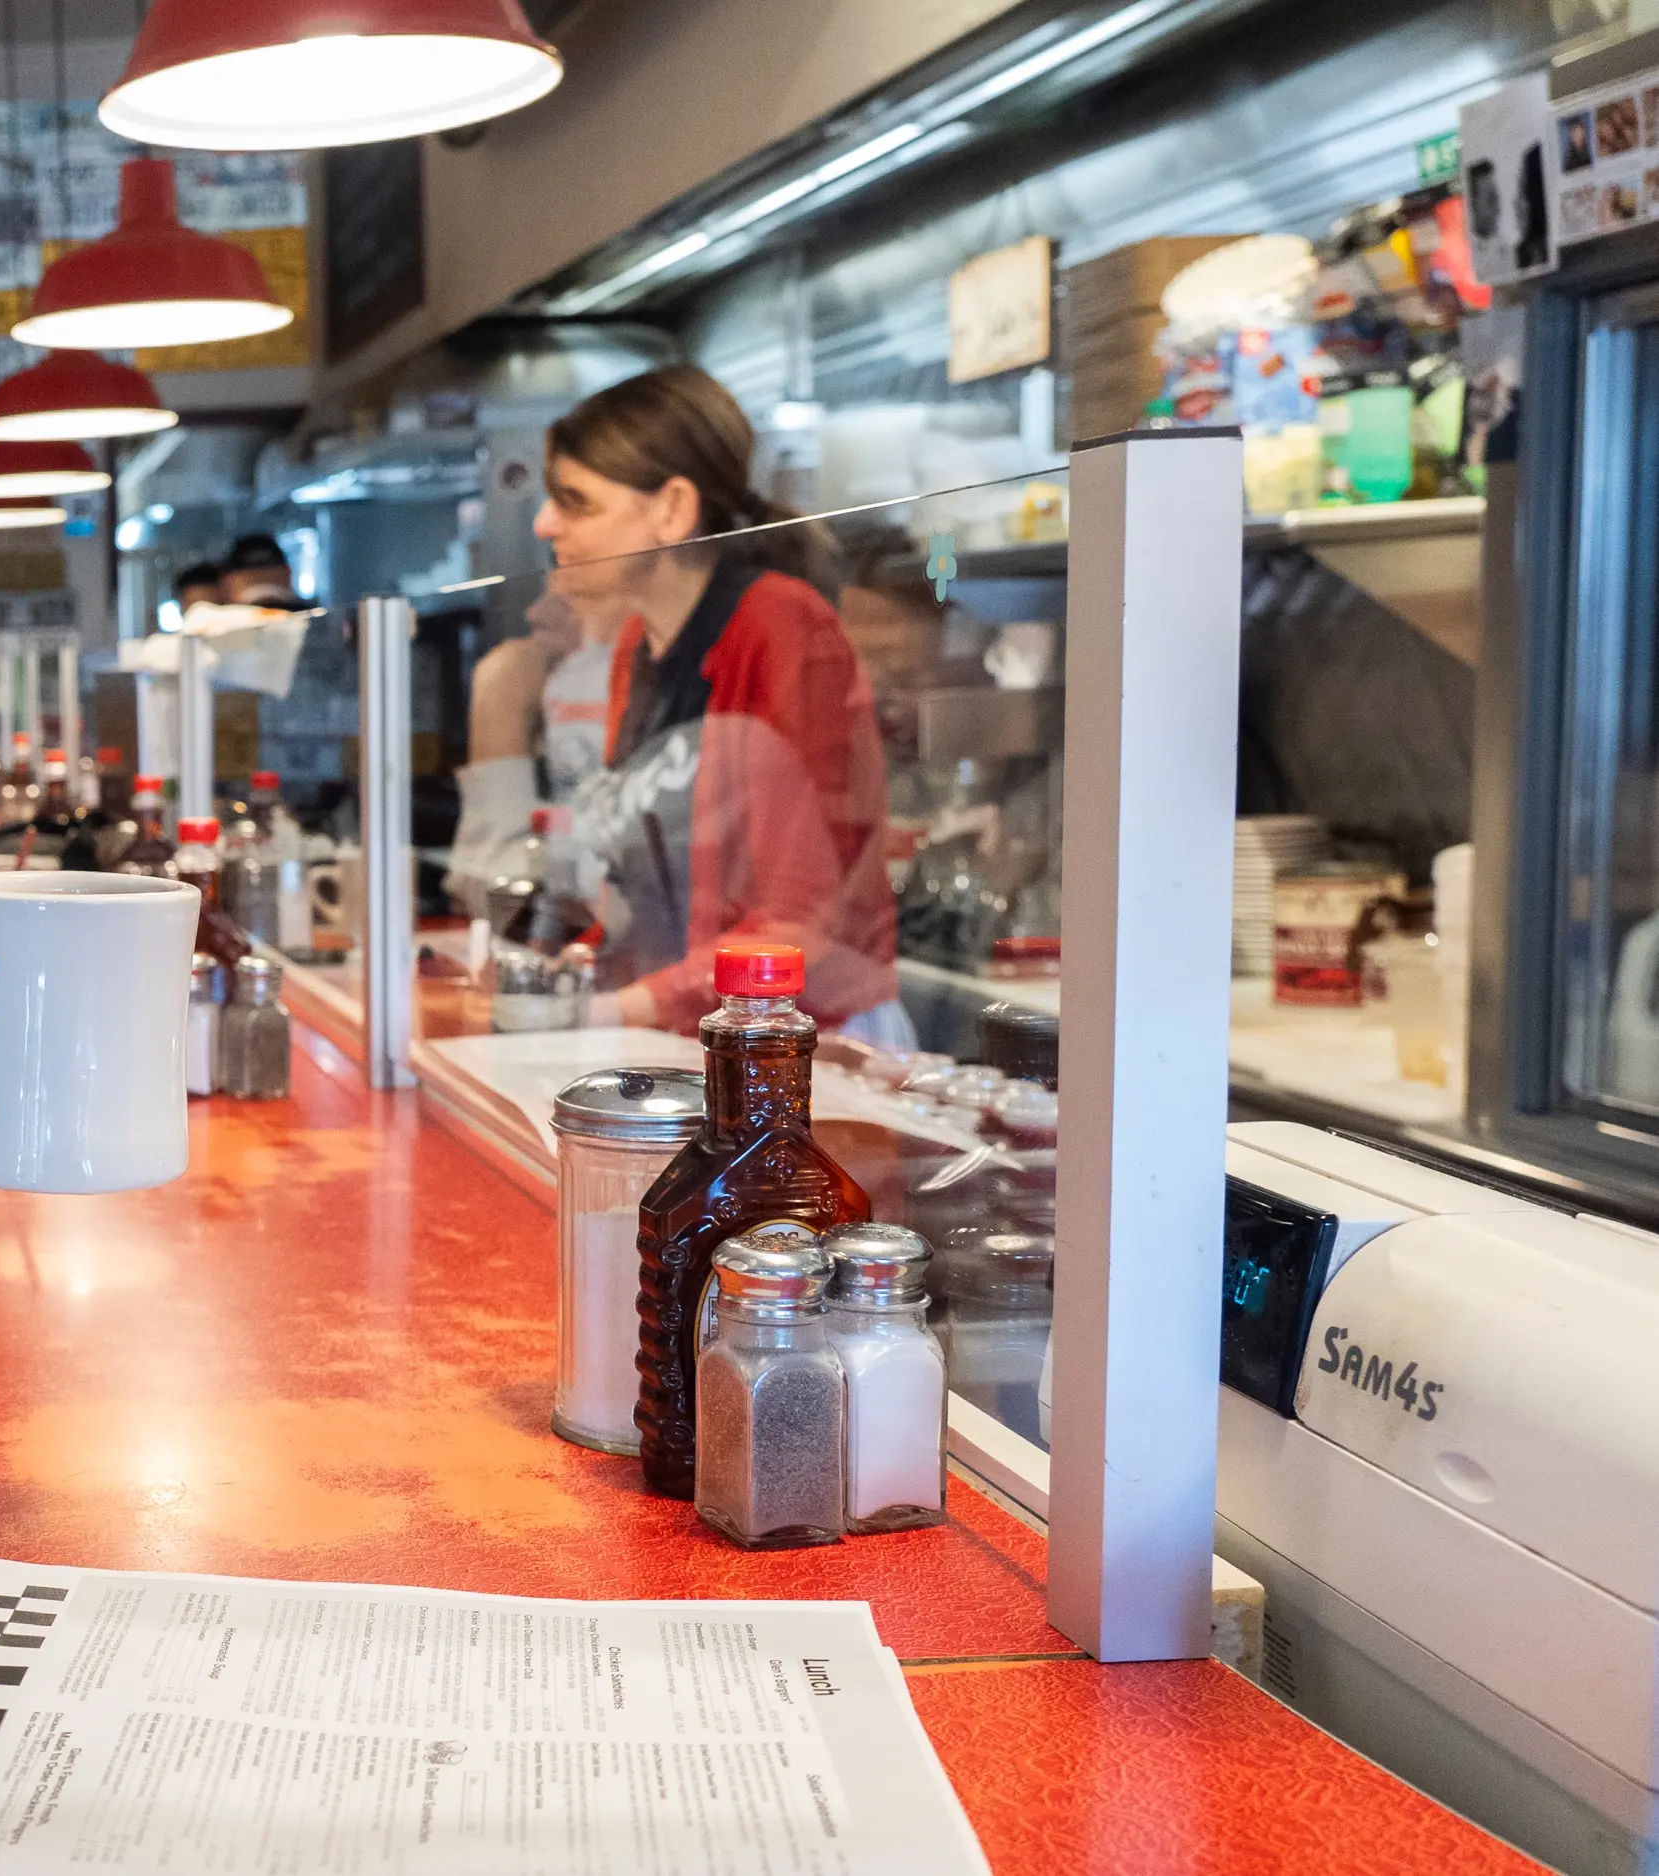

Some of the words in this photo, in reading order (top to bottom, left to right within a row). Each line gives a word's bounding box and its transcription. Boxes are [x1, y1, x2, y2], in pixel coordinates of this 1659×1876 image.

[314, 1599, 327, 1623] California
[418, 1605, 428, 1625] Chicken
[311, 1623, 322, 1635] Club
[416, 1625, 426, 1644] Cordon
[469, 1626, 479, 1646] Chicken
[523, 1628, 533, 1646] Classic
[216, 1627, 236, 1662] Homemade
[360, 1639, 372, 1660] Chicken
[414, 1644, 425, 1656] Bleu
[590, 1633, 600, 1653] Chicken
[524, 1647, 533, 1667] Chicken
[591, 1654, 601, 1676] Sandwich
[608, 1646, 621, 1672] Chicken
[208, 1663, 226, 1679] Soup
[523, 1667, 533, 1679] Club
[769, 1659, 785, 1678] Glen's
[803, 1658, 839, 1695] Lunch
[611, 1673, 624, 1709] Sandwiches
[54, 1731, 71, 1751] Made
[49, 1752, 62, 1761] to
[62, 1747, 82, 1769] Glen's
[40, 1761, 58, 1782] Order
[426, 1767, 439, 1779] Deli
[24, 1784, 48, 1815] Chicken
[9, 1816, 33, 1844] Fingers
